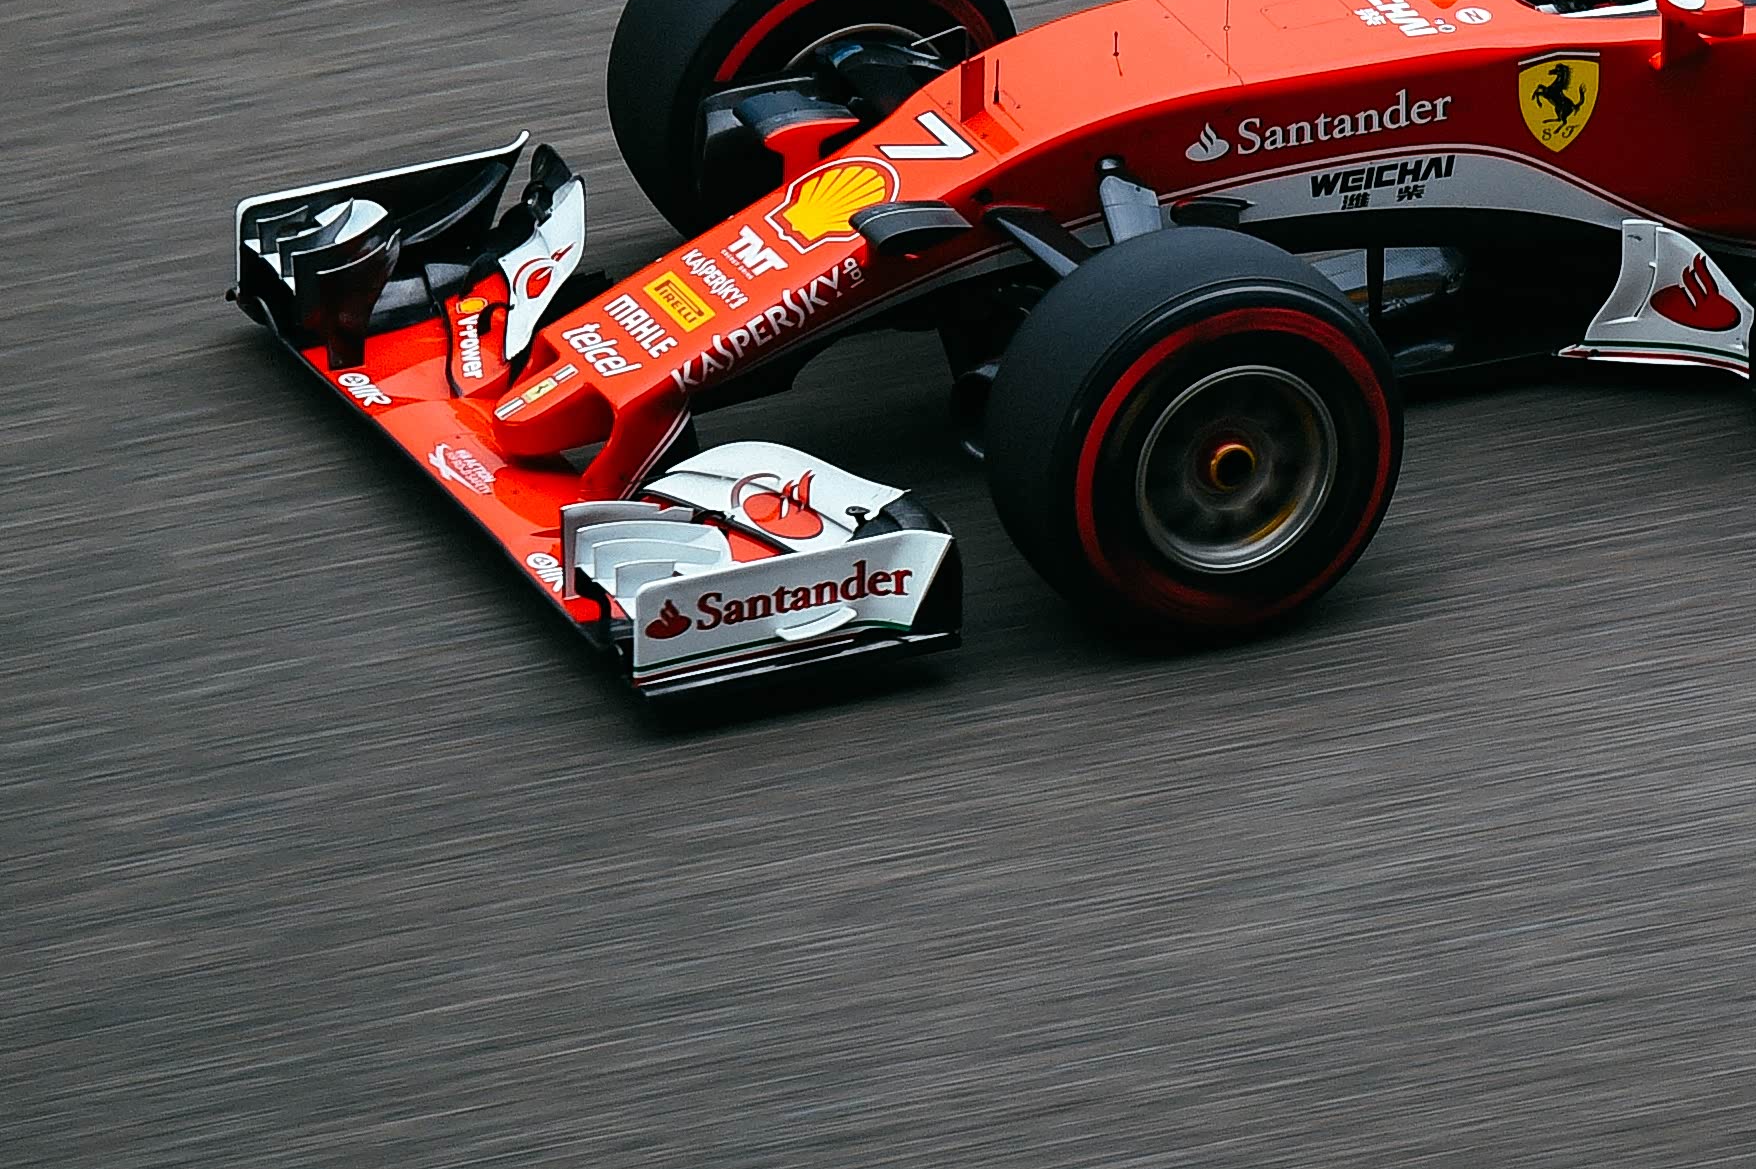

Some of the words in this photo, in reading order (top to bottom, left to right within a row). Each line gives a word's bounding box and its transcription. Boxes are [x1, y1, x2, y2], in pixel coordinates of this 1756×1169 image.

[879, 111, 977, 159] 7
[1237, 89, 1452, 155] Santander
[1310, 155, 1456, 198] WEICHAI
[681, 248, 745, 305] KASPERSKY
[727, 225, 789, 277] TNT
[604, 294, 679, 360] MAHLE
[654, 279, 705, 323] PIRELLI
[670, 266, 843, 393] KASPERSKY
[561, 321, 643, 378] telcel
[695, 560, 913, 630] Santander
